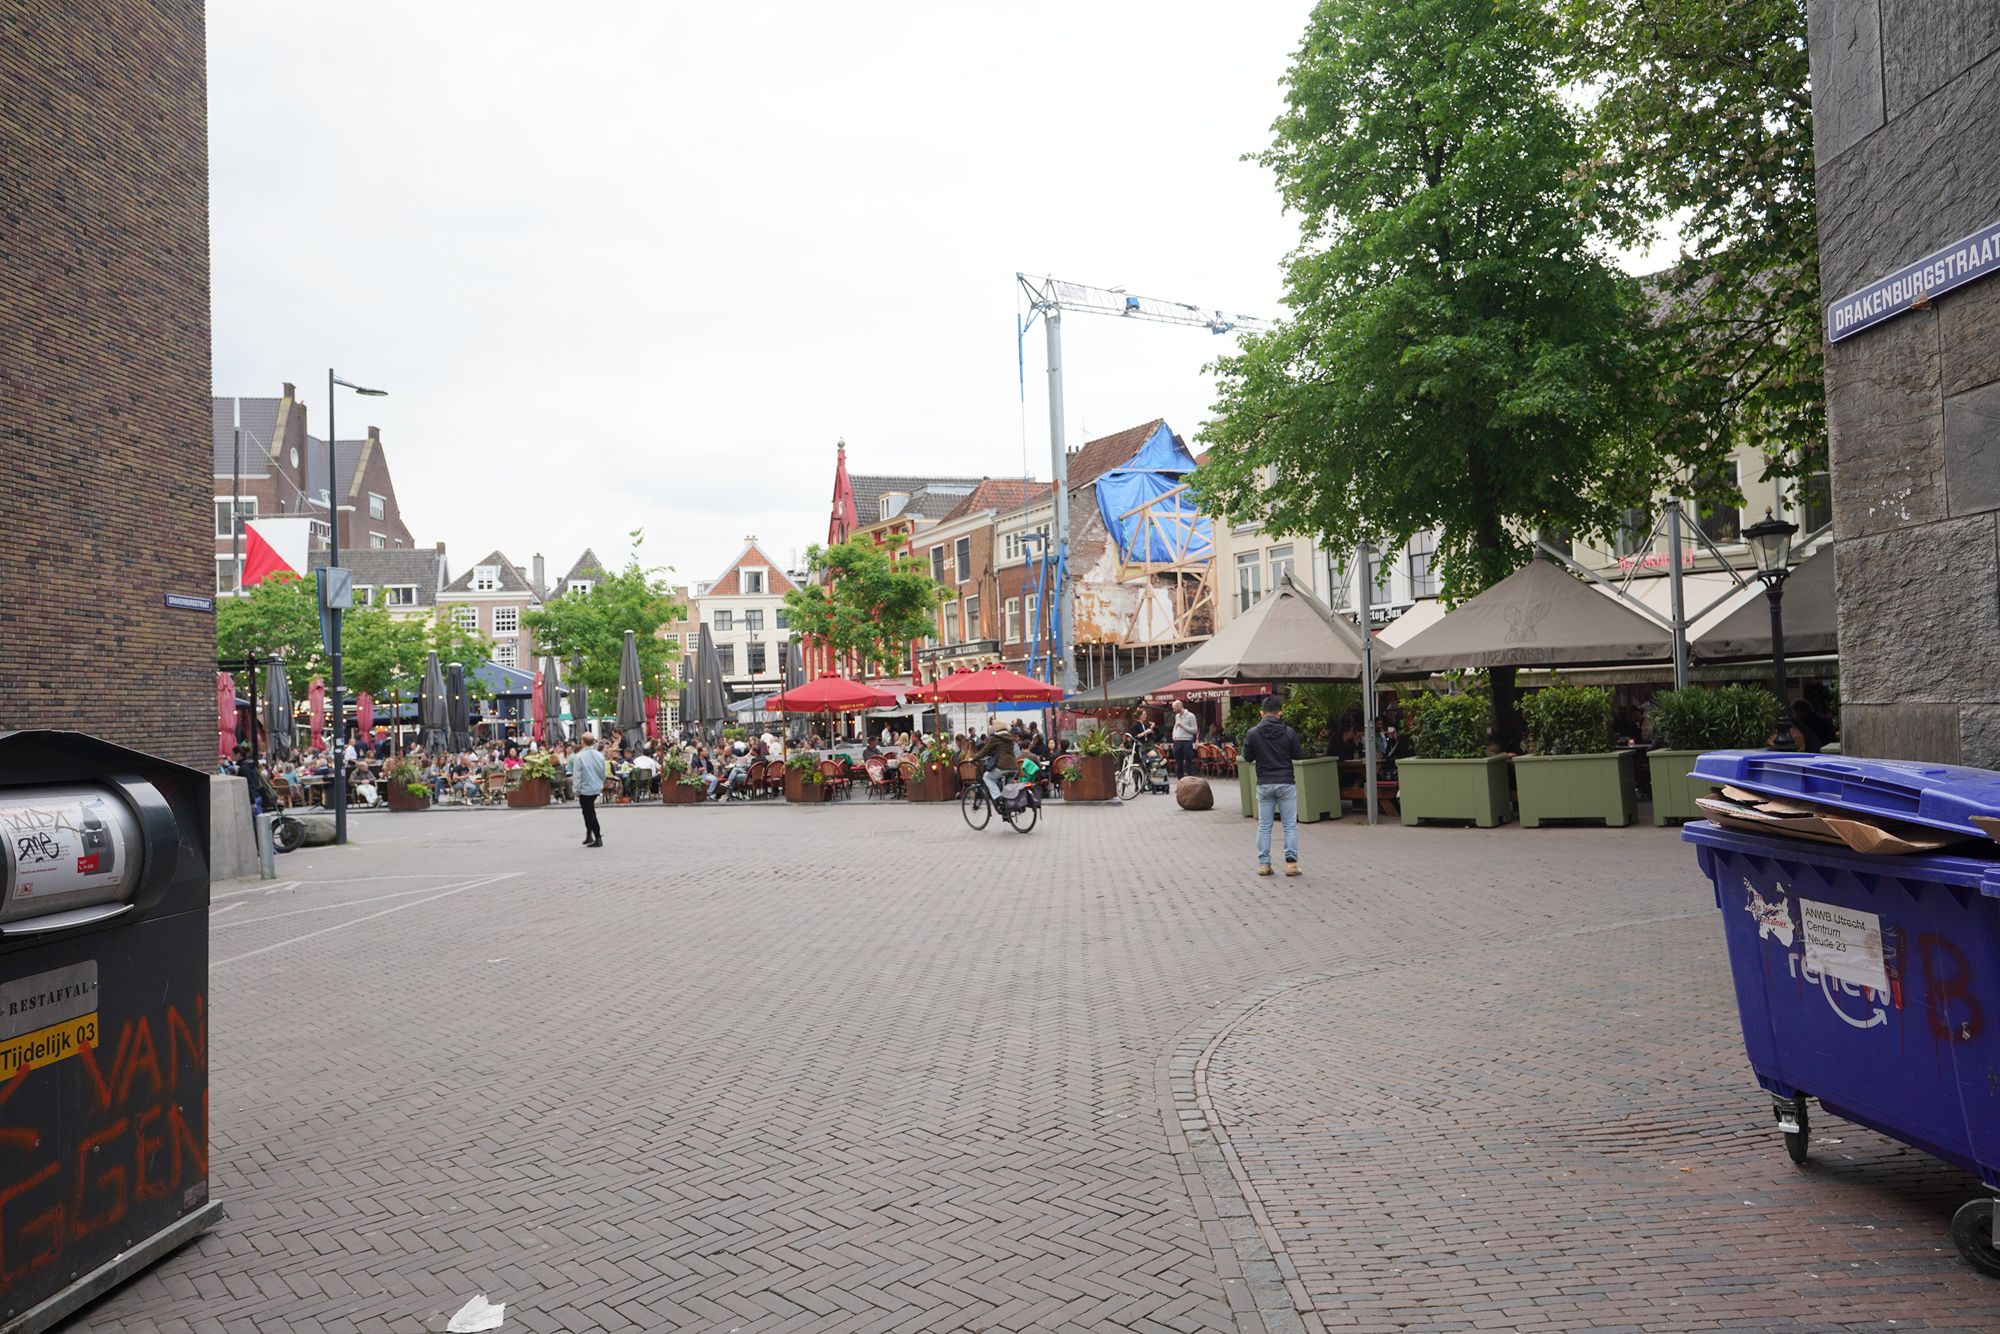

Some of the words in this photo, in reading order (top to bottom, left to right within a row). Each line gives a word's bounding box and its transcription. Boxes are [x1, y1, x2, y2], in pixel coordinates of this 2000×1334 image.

[1835, 232, 2000, 332] DRAKENBURGSTRAAT
[1805, 906, 1832, 923] ANWB
[1833, 912, 1867, 931] Utrecht
[1806, 920, 1841, 938] Centrum
[1807, 934, 1834, 950] Neude
[1835, 940, 1847, 953] 23
[9, 982, 89, 1017] RESTAFVAL
[0, 1031, 71, 1072] Tijdelijk
[76, 1022, 95, 1045] 03
[78, 992, 208, 1106] VAN
